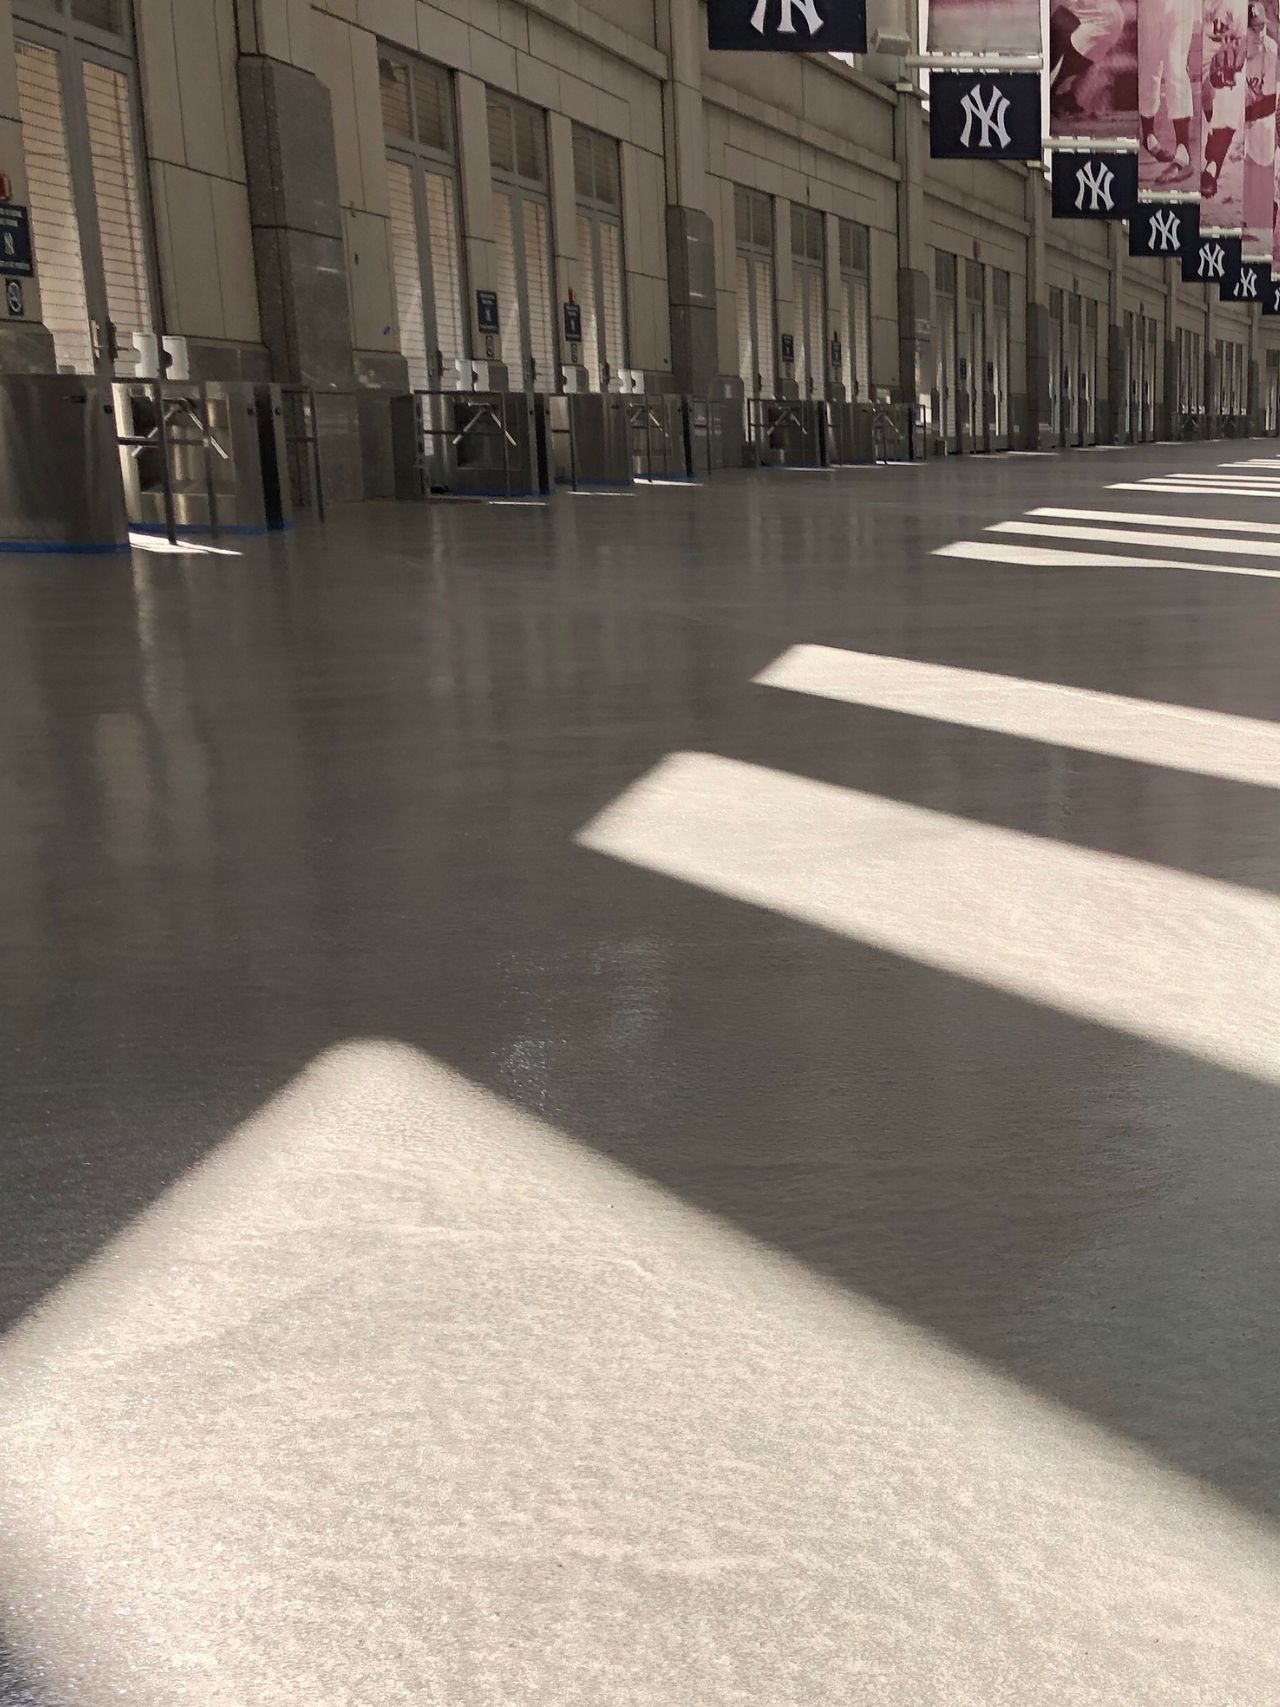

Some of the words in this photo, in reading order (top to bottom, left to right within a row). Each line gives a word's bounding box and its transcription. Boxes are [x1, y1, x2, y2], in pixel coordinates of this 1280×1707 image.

[960, 84, 1012, 149] NY
[1075, 160, 1115, 212] NY
[1148, 209, 1181, 250] NY
[1197, 242, 1226, 278] NY
